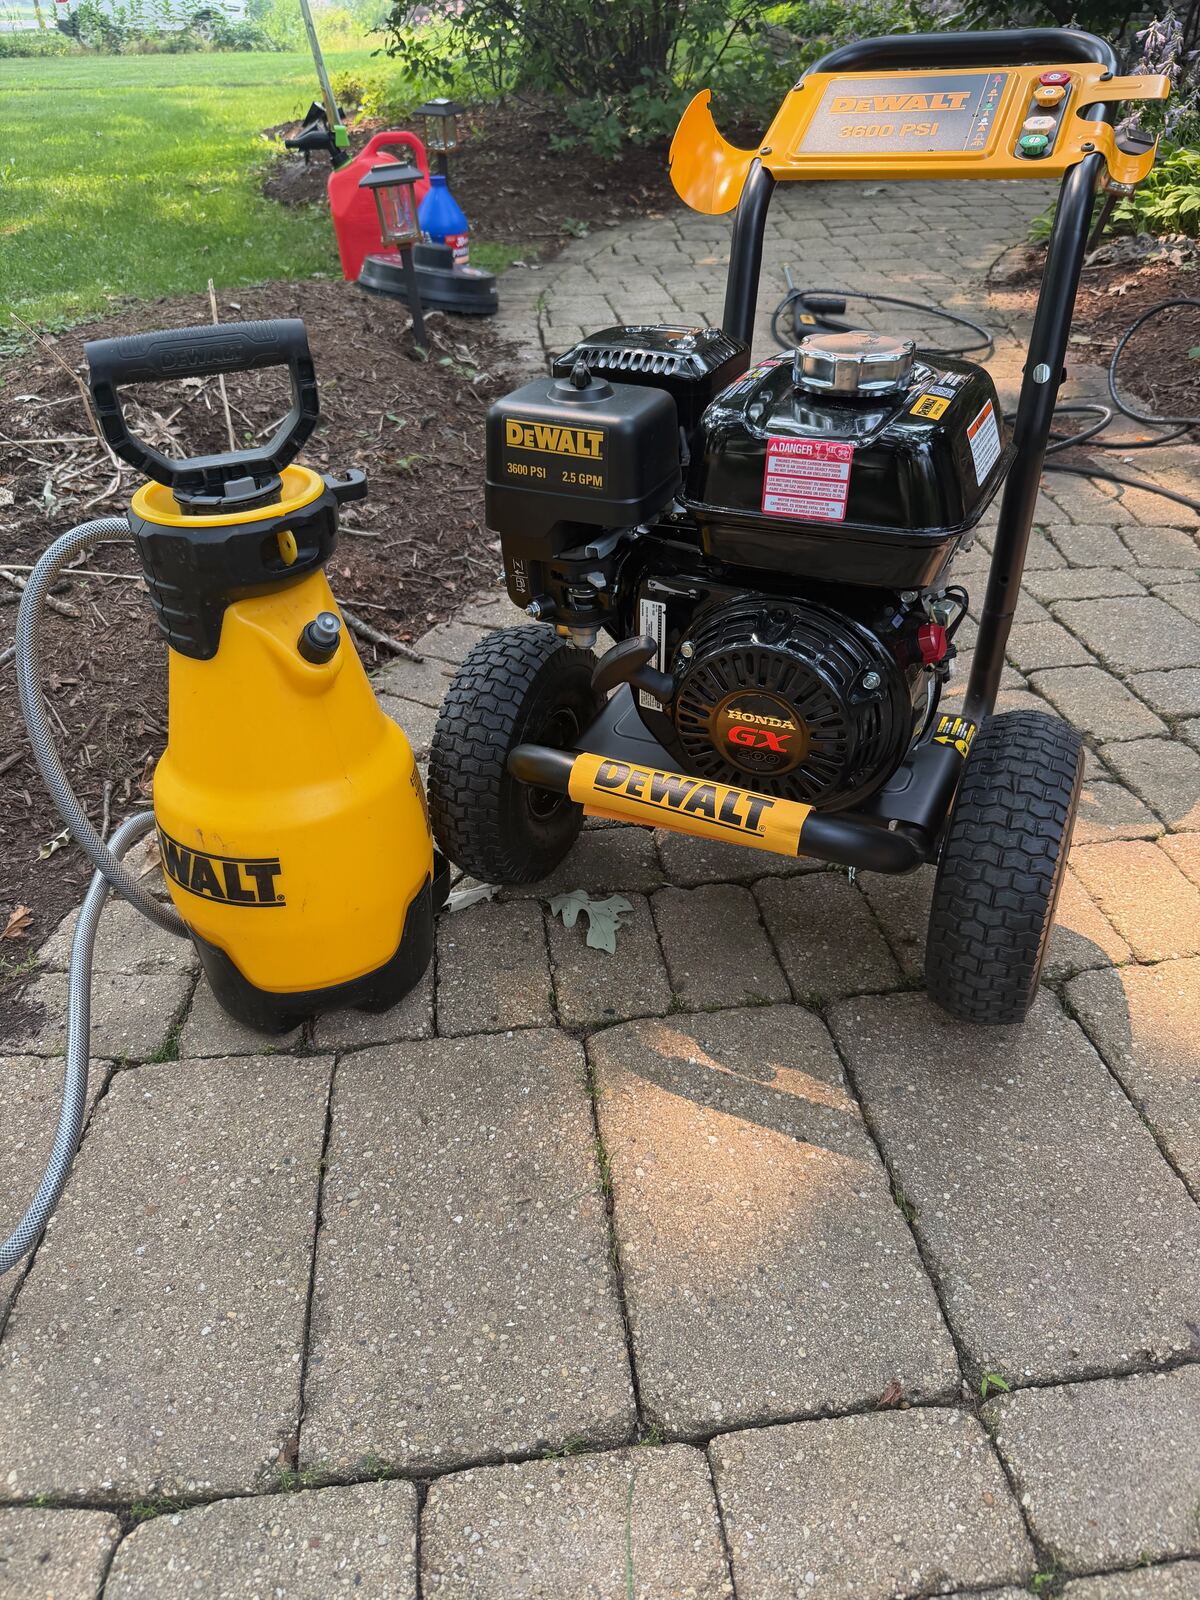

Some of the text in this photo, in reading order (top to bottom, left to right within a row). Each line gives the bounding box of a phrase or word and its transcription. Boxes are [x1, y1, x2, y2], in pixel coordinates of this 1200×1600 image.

[829, 93, 970, 113] DEWALT
[838, 122, 939, 138] 3600 PSI
[160, 344, 243, 369] DEWALT
[506, 422, 604, 457] DEWALT
[779, 442, 813, 455] DANGER
[507, 462, 603, 487] 3600 PSI 2.5 GPM
[727, 709, 796, 730] HONDA
[728, 725, 793, 753] GX
[595, 760, 775, 831] DEWALT
[159, 830, 282, 902] WALT
